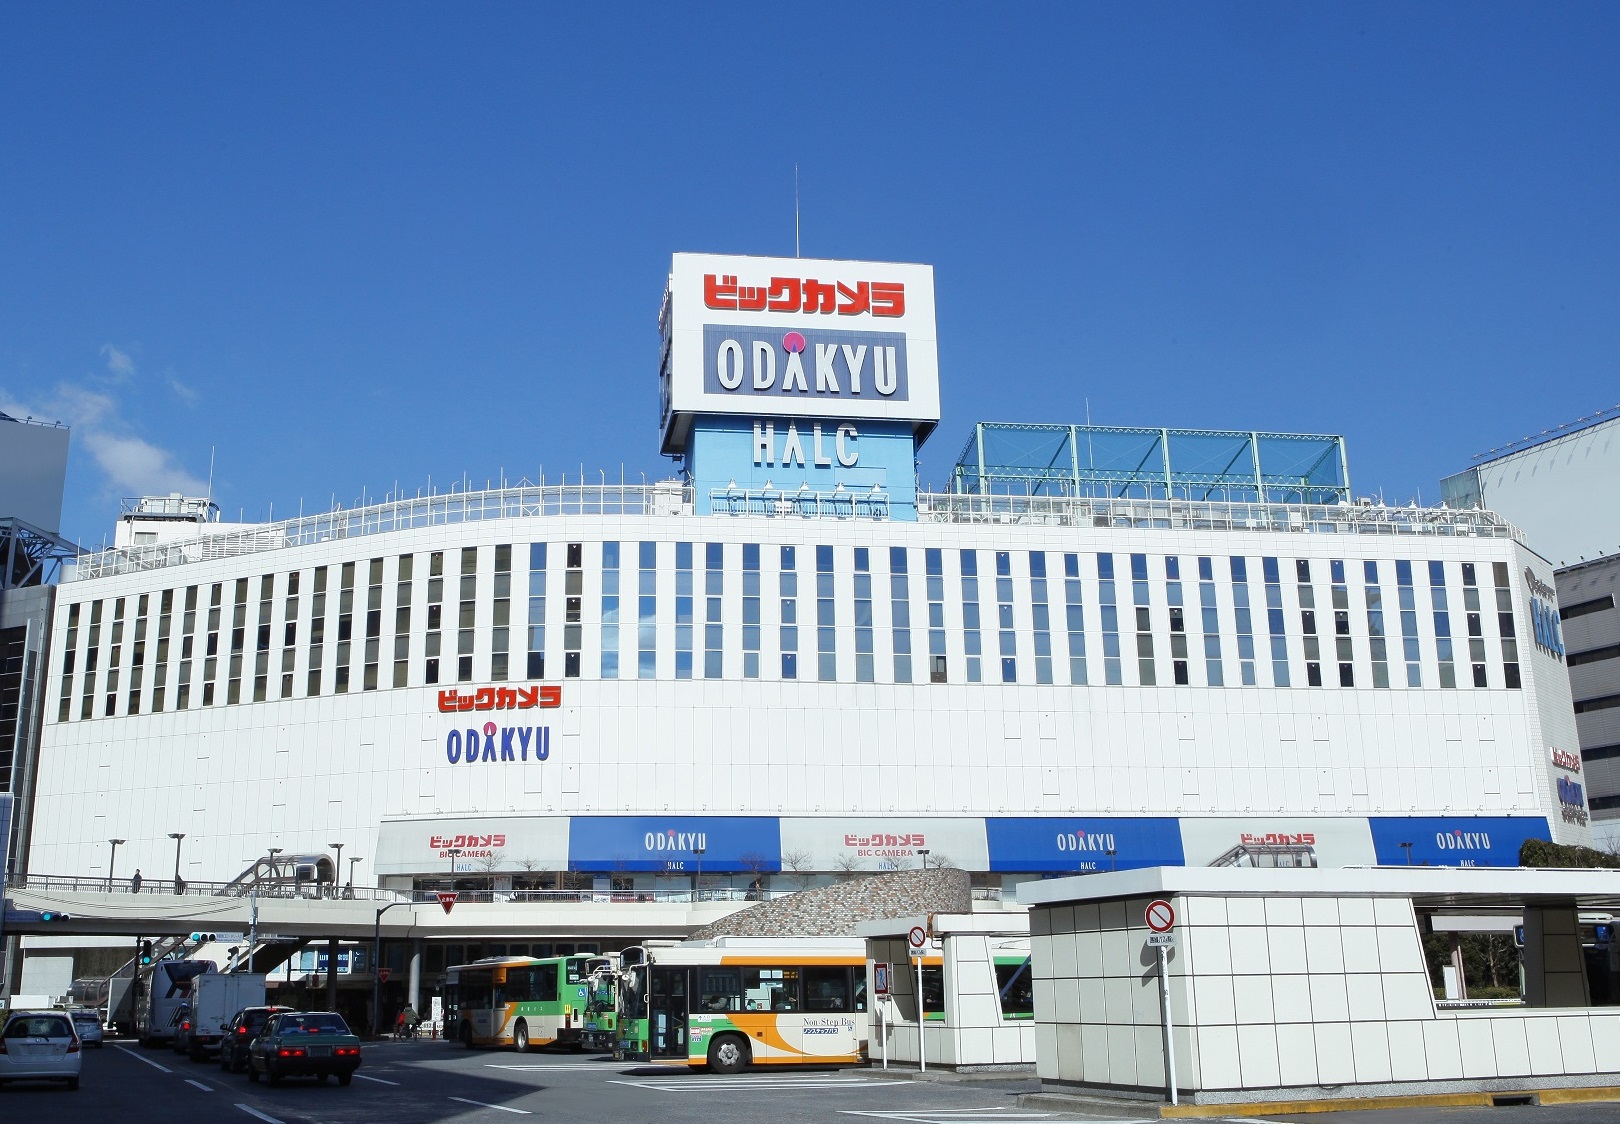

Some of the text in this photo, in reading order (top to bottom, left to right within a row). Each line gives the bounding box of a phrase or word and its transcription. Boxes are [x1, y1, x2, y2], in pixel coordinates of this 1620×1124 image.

[704, 274, 905, 318] ビックカメラ
[717, 331, 898, 395] ODAKYU
[754, 418, 859, 467] HALC
[438, 686, 561, 713] ビックカメラ
[446, 721, 550, 764] ODAKYU
[430, 835, 506, 848] ビックカメラ
[645, 830, 706, 852] ODAKYU
[844, 834, 925, 846] ビックカメラ
[1057, 831, 1115, 851] ODAKYU
[1436, 830, 1490, 850] ODAKYU
[455, 849, 492, 858] CAMERA
[667, 862, 684, 870] HALC
[878, 862, 895, 870] HALC
[1080, 862, 1096, 870] HALC
[841, 1017, 855, 1026] Bus
[803, 1027, 838, 1035] ノンステップバス
